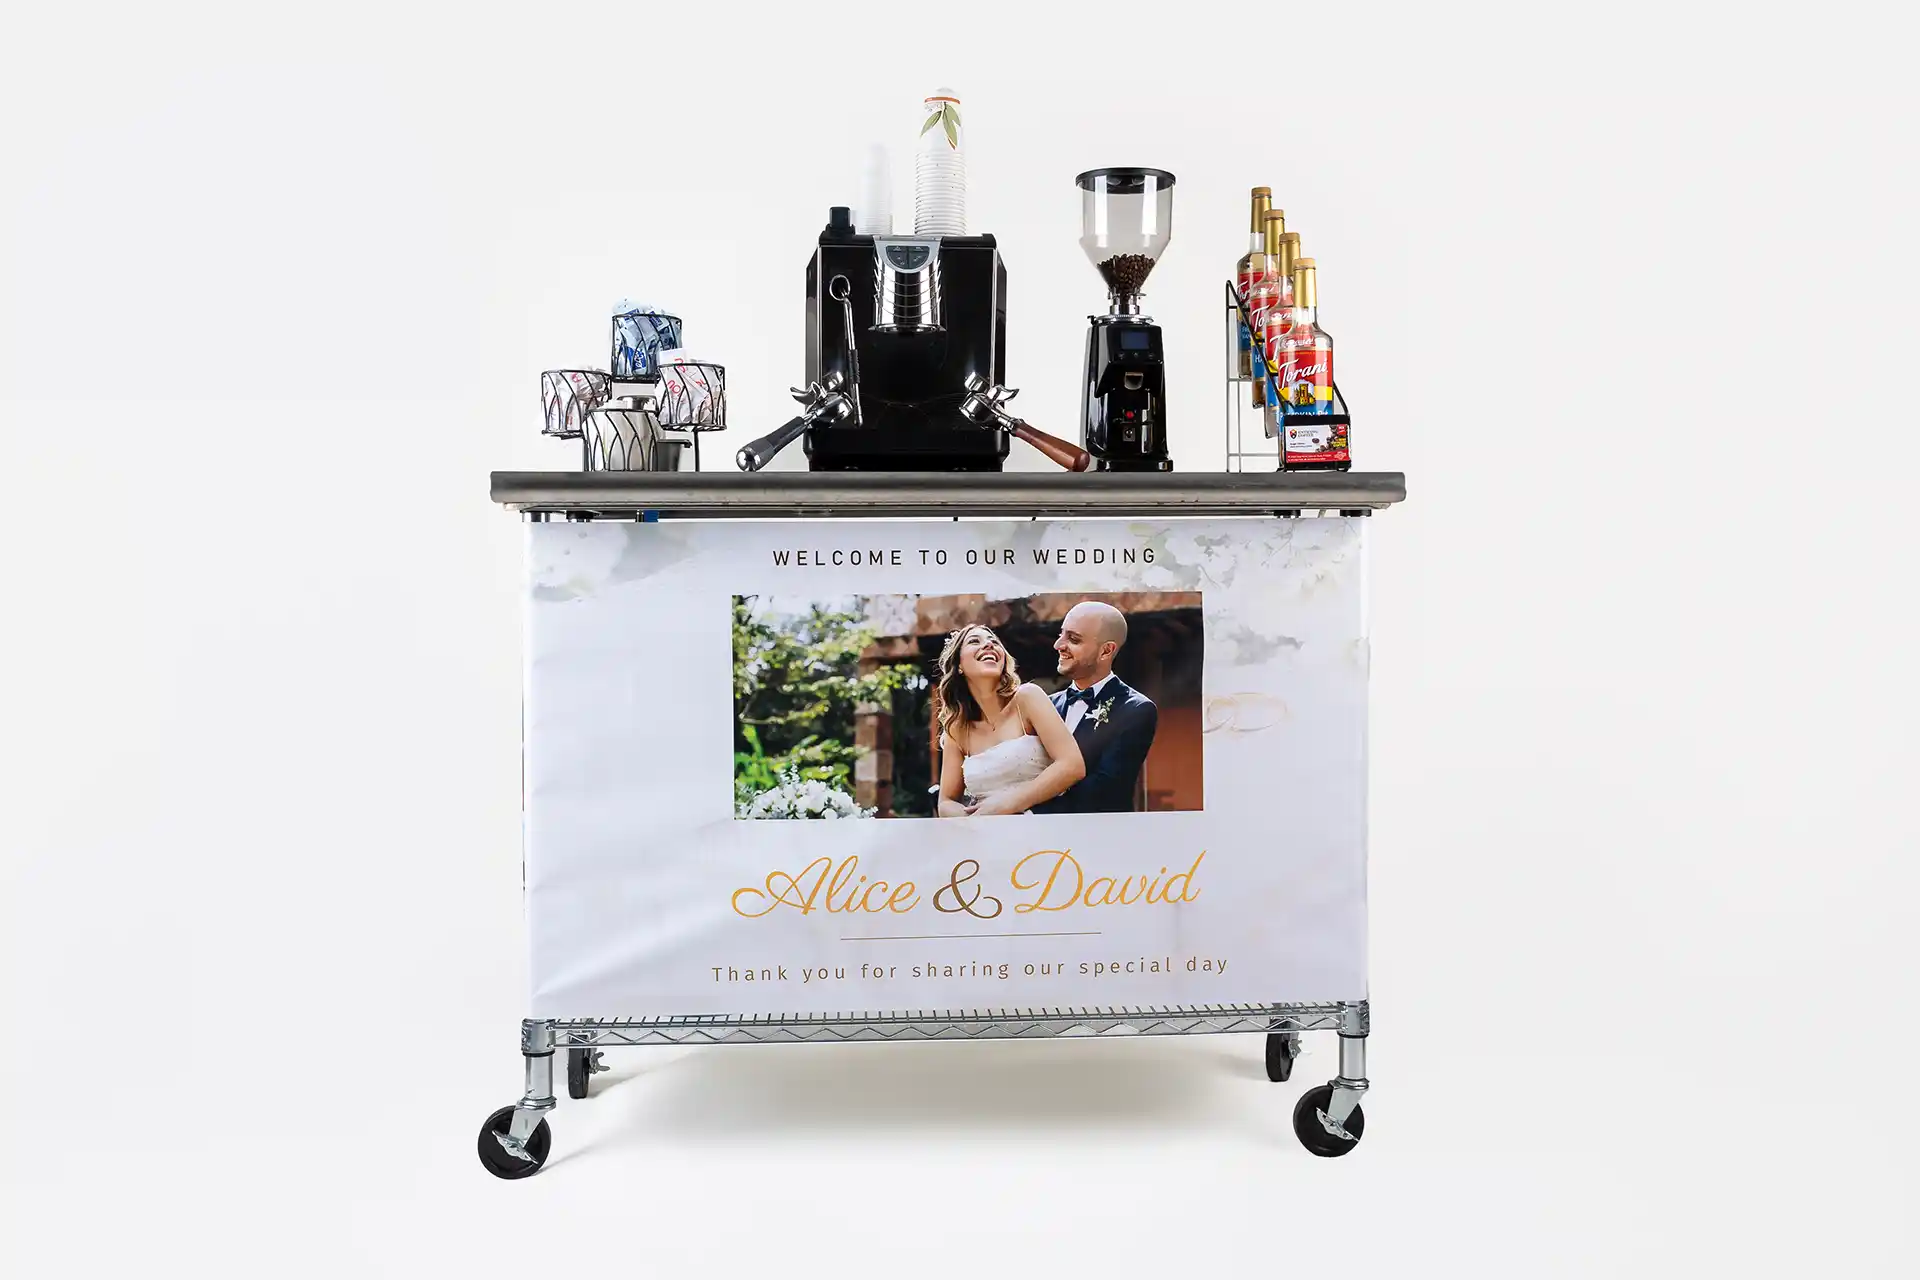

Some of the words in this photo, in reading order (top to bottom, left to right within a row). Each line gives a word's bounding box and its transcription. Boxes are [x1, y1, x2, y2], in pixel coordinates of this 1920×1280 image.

[1277, 359, 1328, 390] Torani
[772, 549, 903, 567] WELCOME
[918, 549, 948, 565] TO
[965, 549, 1016, 565] OUR
[1033, 547, 1157, 565] WEDDING
[731, 854, 921, 919] Alice
[932, 858, 1003, 920] &
[1010, 848, 1207, 914] David
[711, 964, 789, 983] Thank
[802, 967, 845, 984] you
[861, 963, 897, 979] for
[911, 961, 1009, 980] sharing
[1024, 962, 1065, 976] our
[1079, 957, 1171, 977] special
[1185, 956, 1229, 975] day
